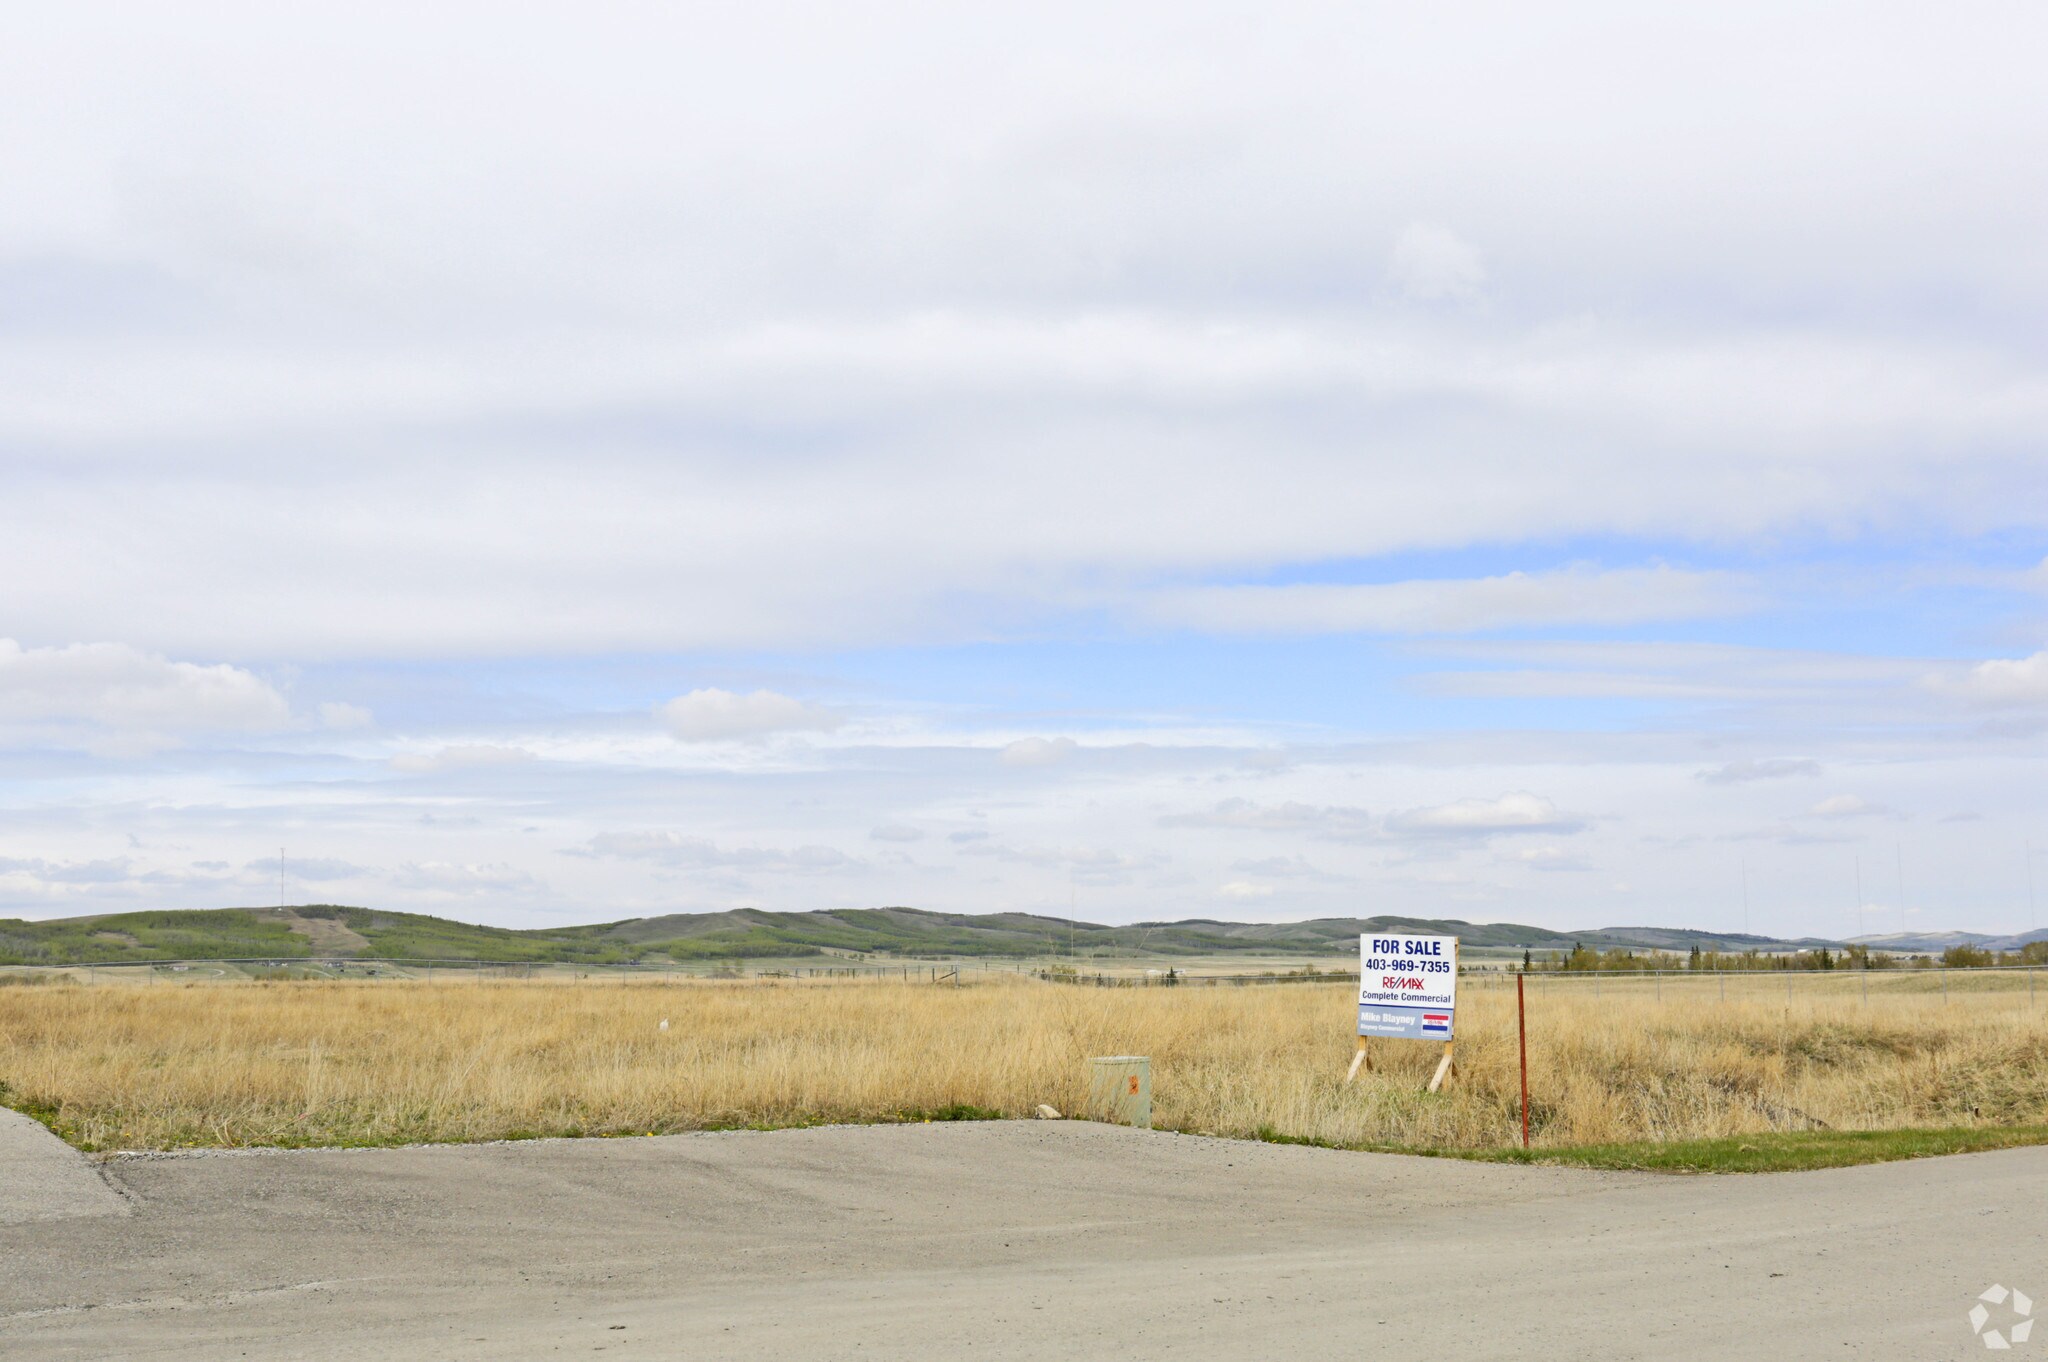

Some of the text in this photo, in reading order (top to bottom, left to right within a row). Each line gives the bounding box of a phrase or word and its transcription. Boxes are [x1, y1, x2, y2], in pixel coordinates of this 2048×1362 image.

[1373, 939, 1441, 956] FOR SALE
[1366, 958, 1450, 973] 403-969-7355
[1382, 976, 1425, 990] RE/MAX
[1362, 990, 1451, 1003] Complete Commercial
[1360, 1012, 1381, 1022] Mike
[1382, 1013, 1416, 1025] Blayney
